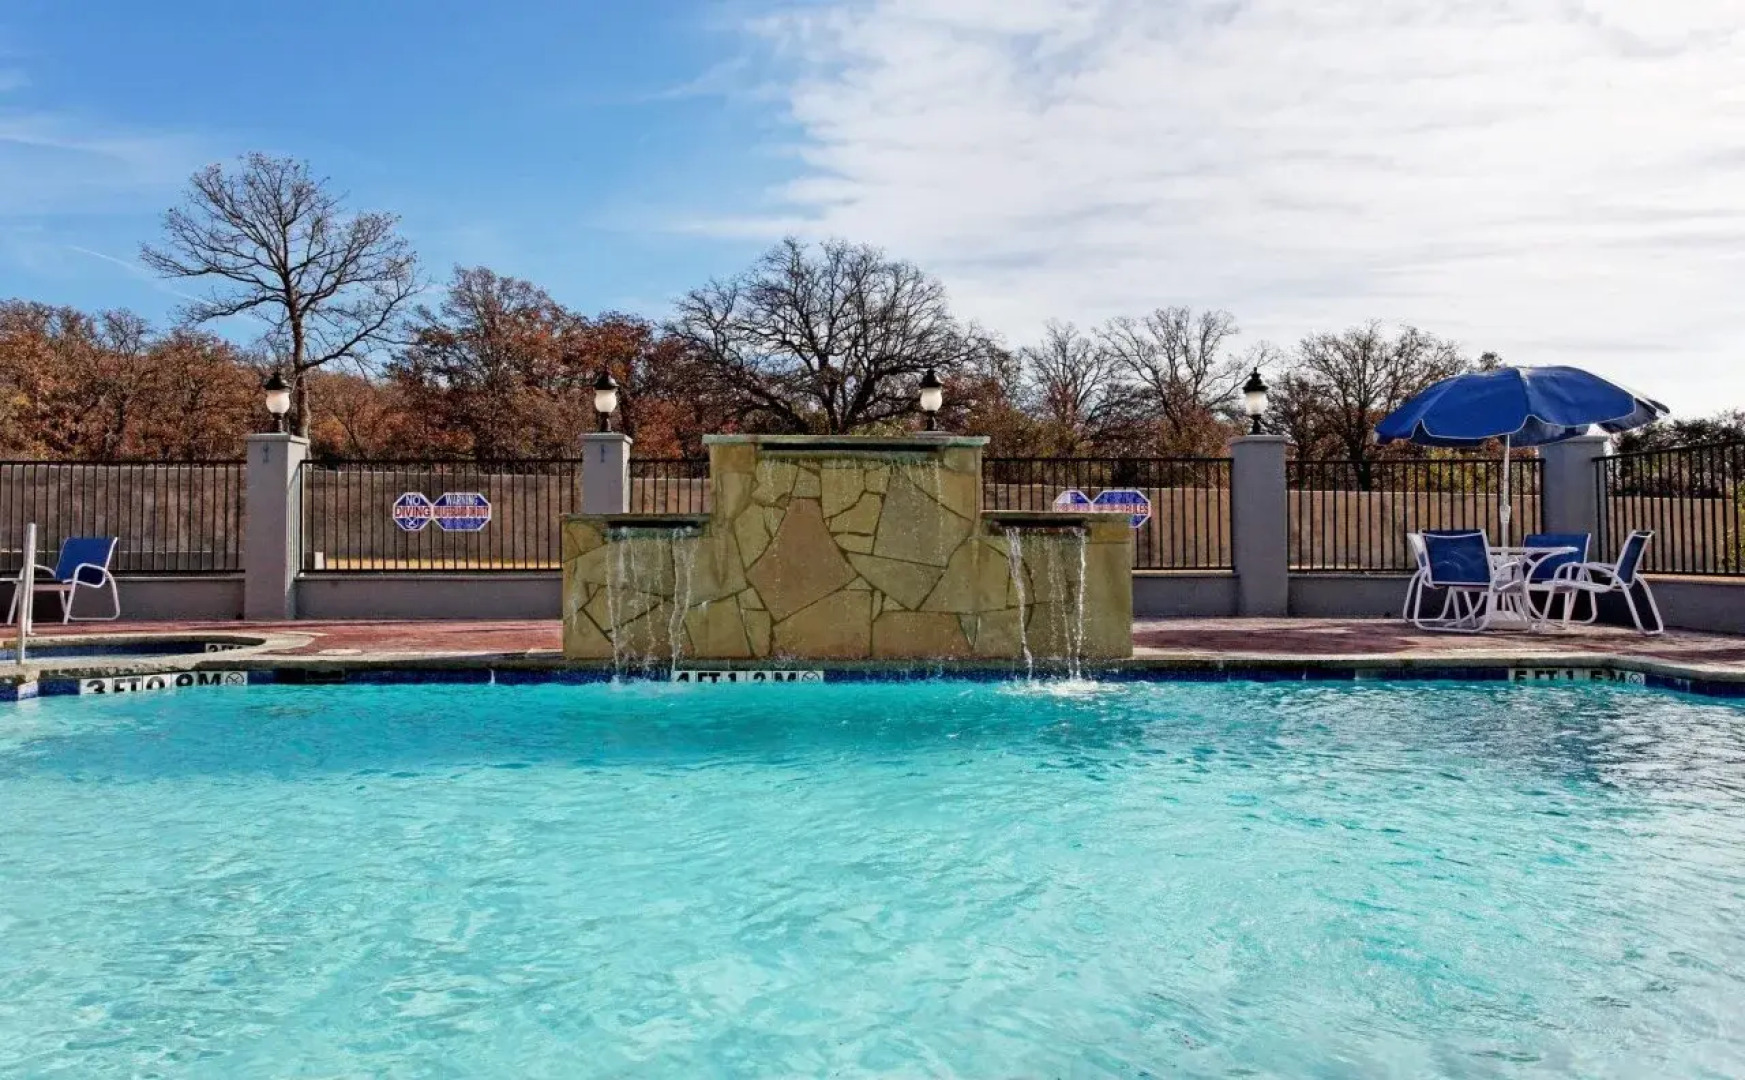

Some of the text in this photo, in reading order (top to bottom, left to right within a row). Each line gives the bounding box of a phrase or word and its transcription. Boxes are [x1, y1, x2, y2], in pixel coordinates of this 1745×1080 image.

[405, 494, 421, 506] NO
[445, 494, 479, 506] WARNING
[395, 506, 431, 518] DIVING
